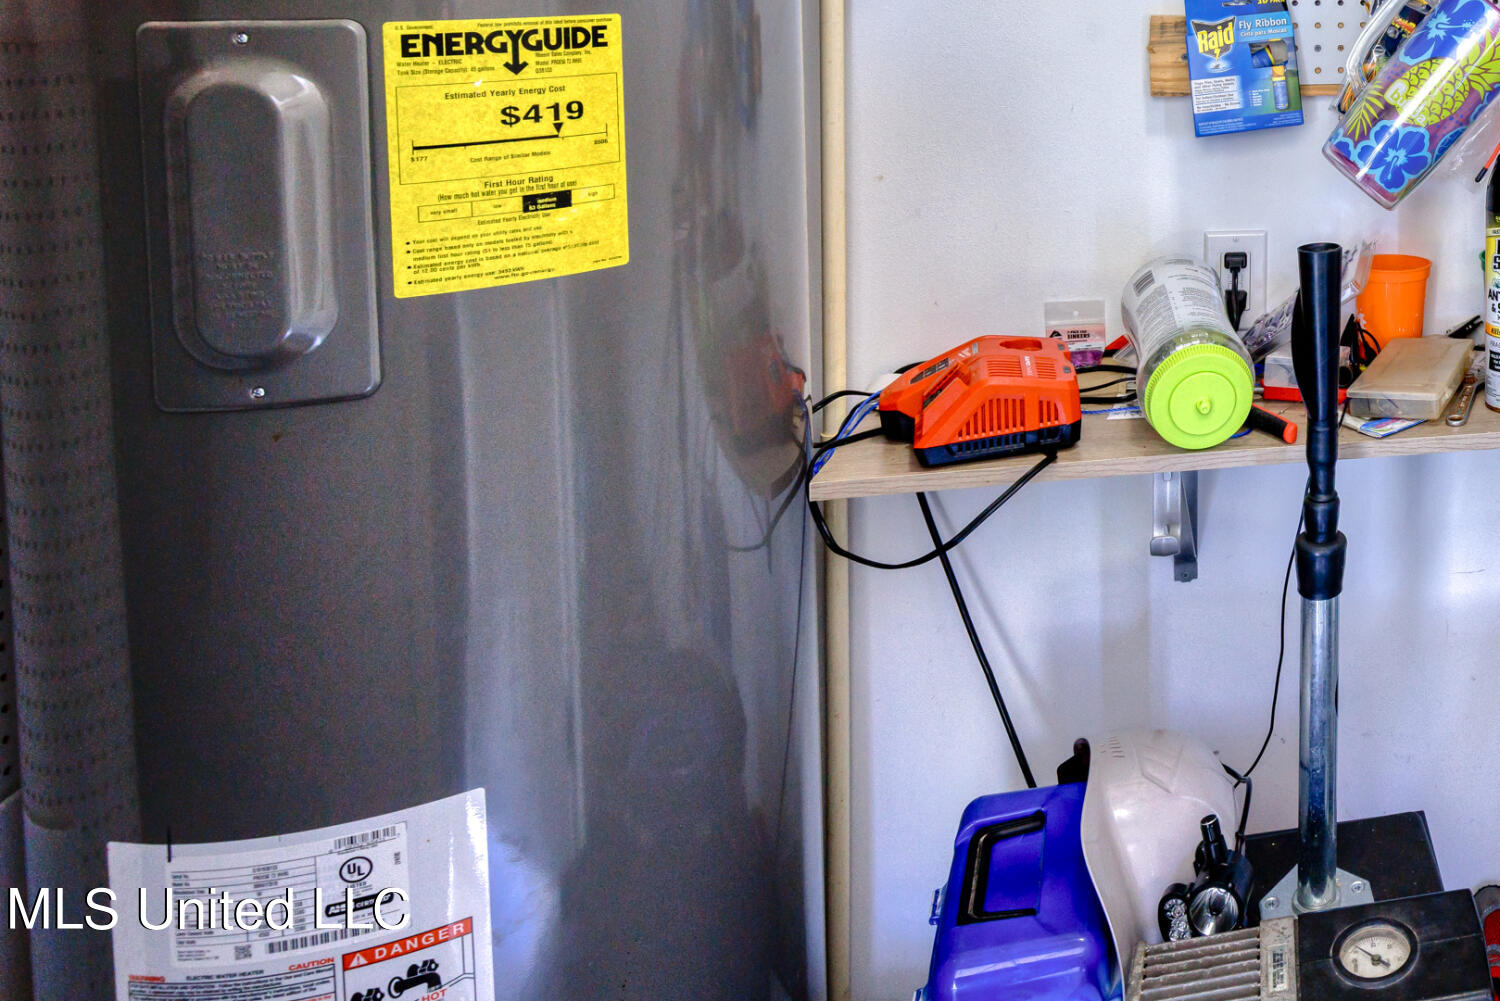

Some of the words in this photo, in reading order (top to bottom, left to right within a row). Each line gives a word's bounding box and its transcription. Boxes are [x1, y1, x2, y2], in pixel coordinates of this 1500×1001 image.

[1238, 20, 1252, 30] Fly
[1255, 17, 1287, 28] Ribbon
[401, 25, 608, 58] ENERGYGUIDE
[1197, 21, 1235, 54] Raid
[444, 91, 487, 100] Estimated
[490, 88, 516, 98] Yearly
[518, 86, 546, 96] Energy
[548, 84, 566, 92] Cost
[500, 100, 584, 128] $419
[484, 181, 503, 189] First
[506, 178, 525, 186] Hour
[528, 175, 554, 184] Rating
[1491, 303, 1496, 313] &
[346, 862, 366, 877] UL
[374, 922, 465, 960] DANGER
[288, 957, 335, 972] CAUTION
[421, 988, 448, 1001] HOT
